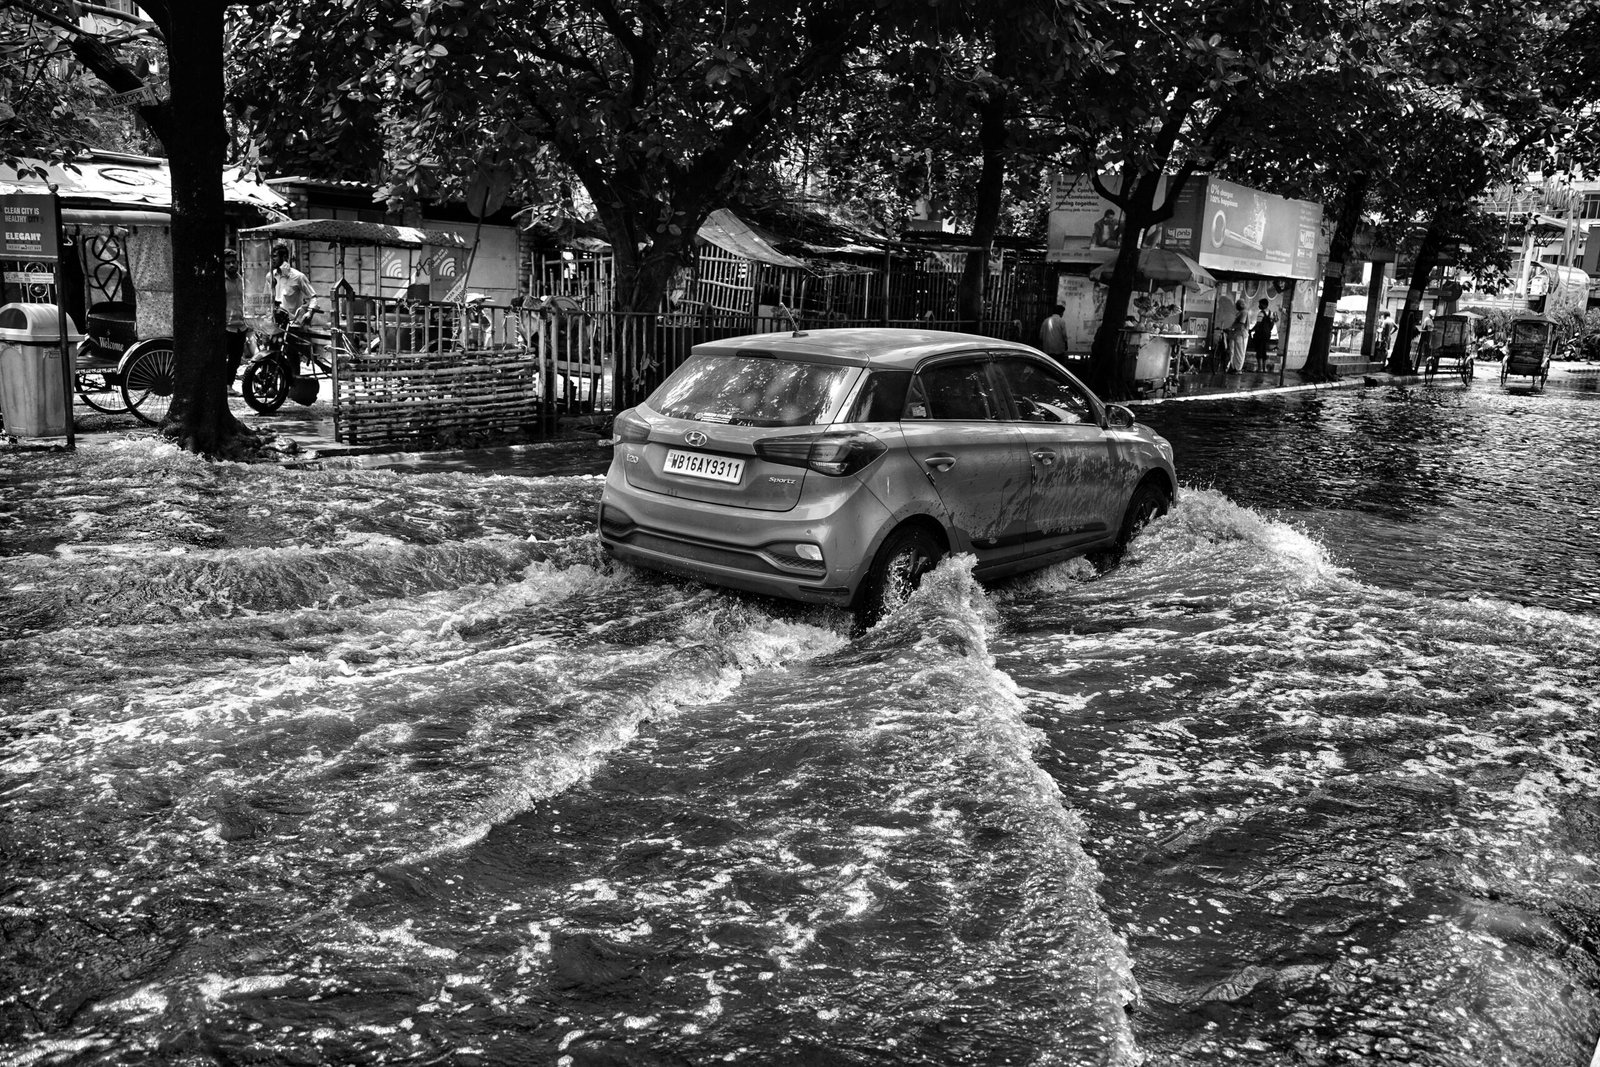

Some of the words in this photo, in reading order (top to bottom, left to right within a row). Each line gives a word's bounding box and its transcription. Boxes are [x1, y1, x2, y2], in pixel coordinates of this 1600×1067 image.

[4, 207, 20, 215] CLEAN
[21, 207, 33, 215] CITY
[5, 215, 27, 223] HEALTHY
[5, 232, 41, 240] ELEGANT
[1177, 230, 1191, 238] pnb
[99, 336, 124, 351] Welcome
[671, 453, 740, 479] WB16AY9311
[768, 476, 796, 485] Sportz
